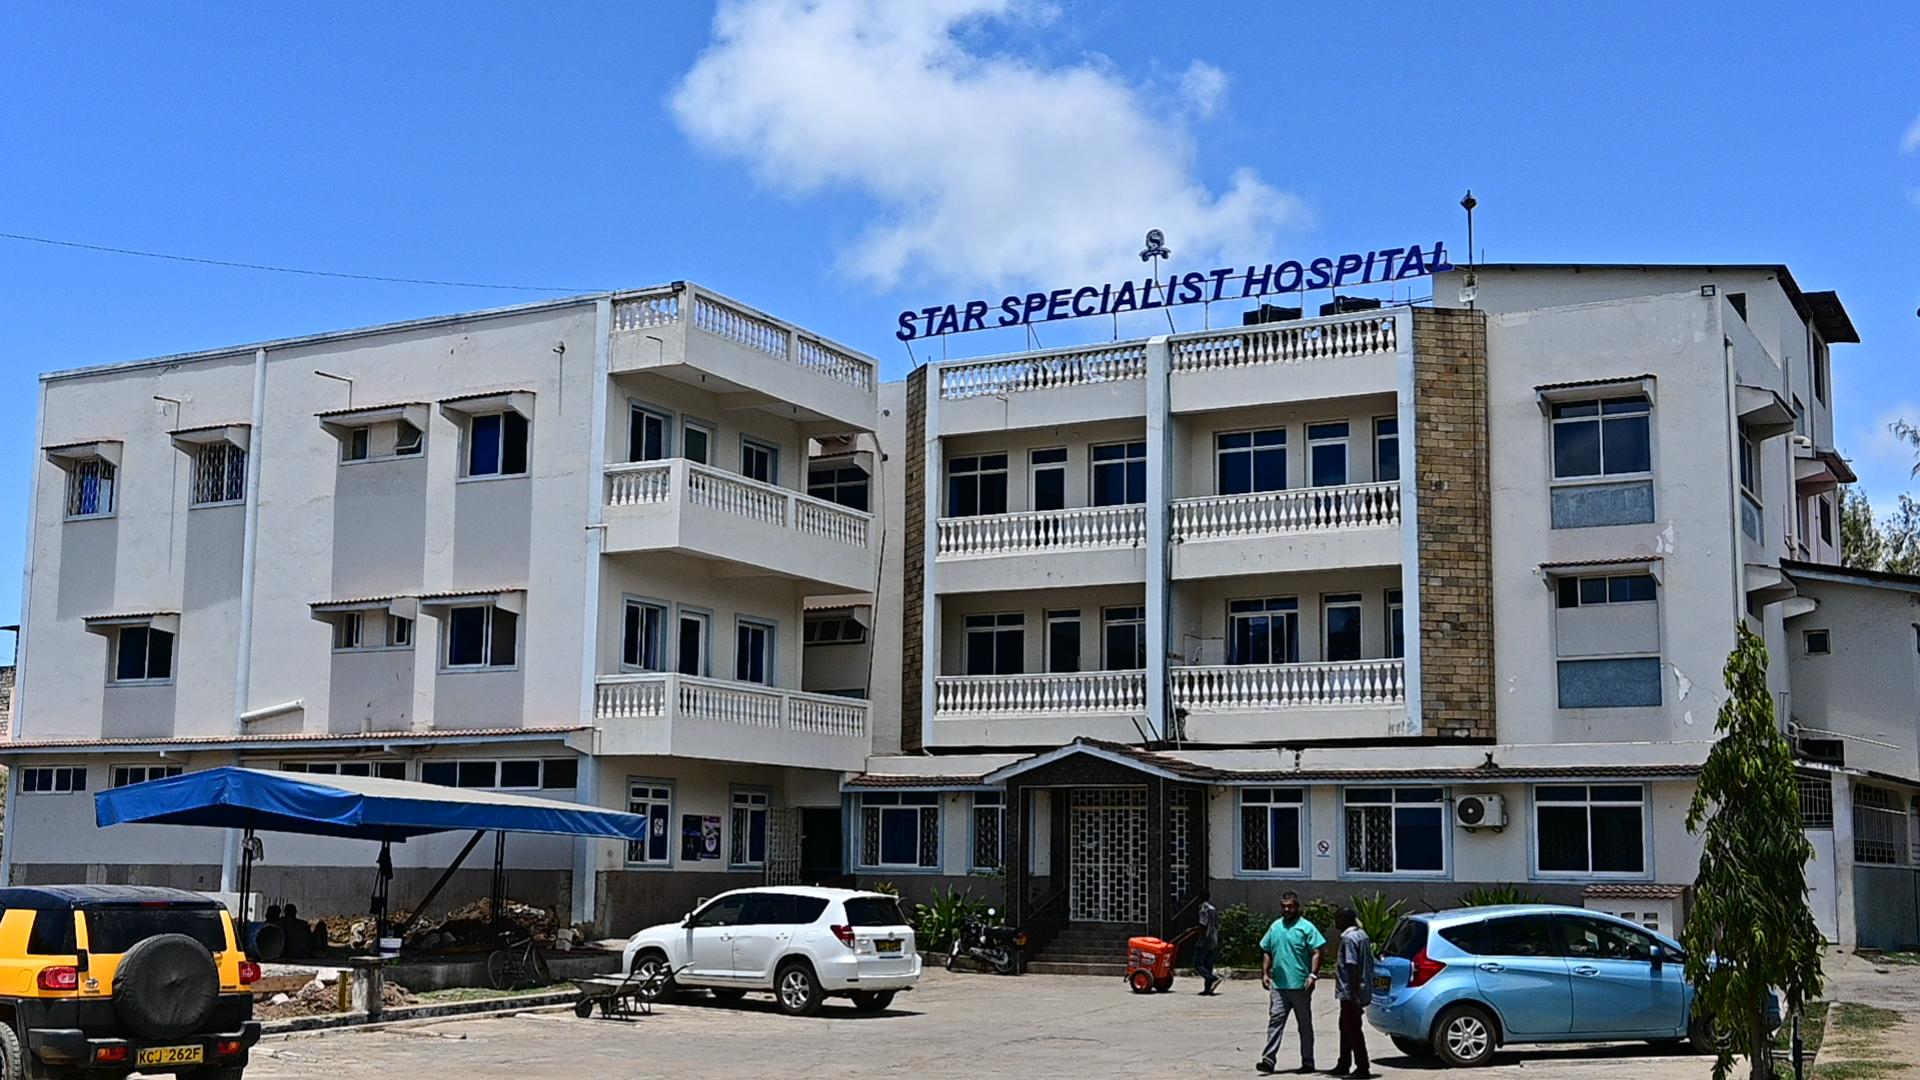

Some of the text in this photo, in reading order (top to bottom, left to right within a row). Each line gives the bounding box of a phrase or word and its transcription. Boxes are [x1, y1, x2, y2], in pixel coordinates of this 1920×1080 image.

[896, 241, 1455, 341] STAR SPECIALIST HOSPITAL
[139, 1048, 201, 1064] KCJ 262F
